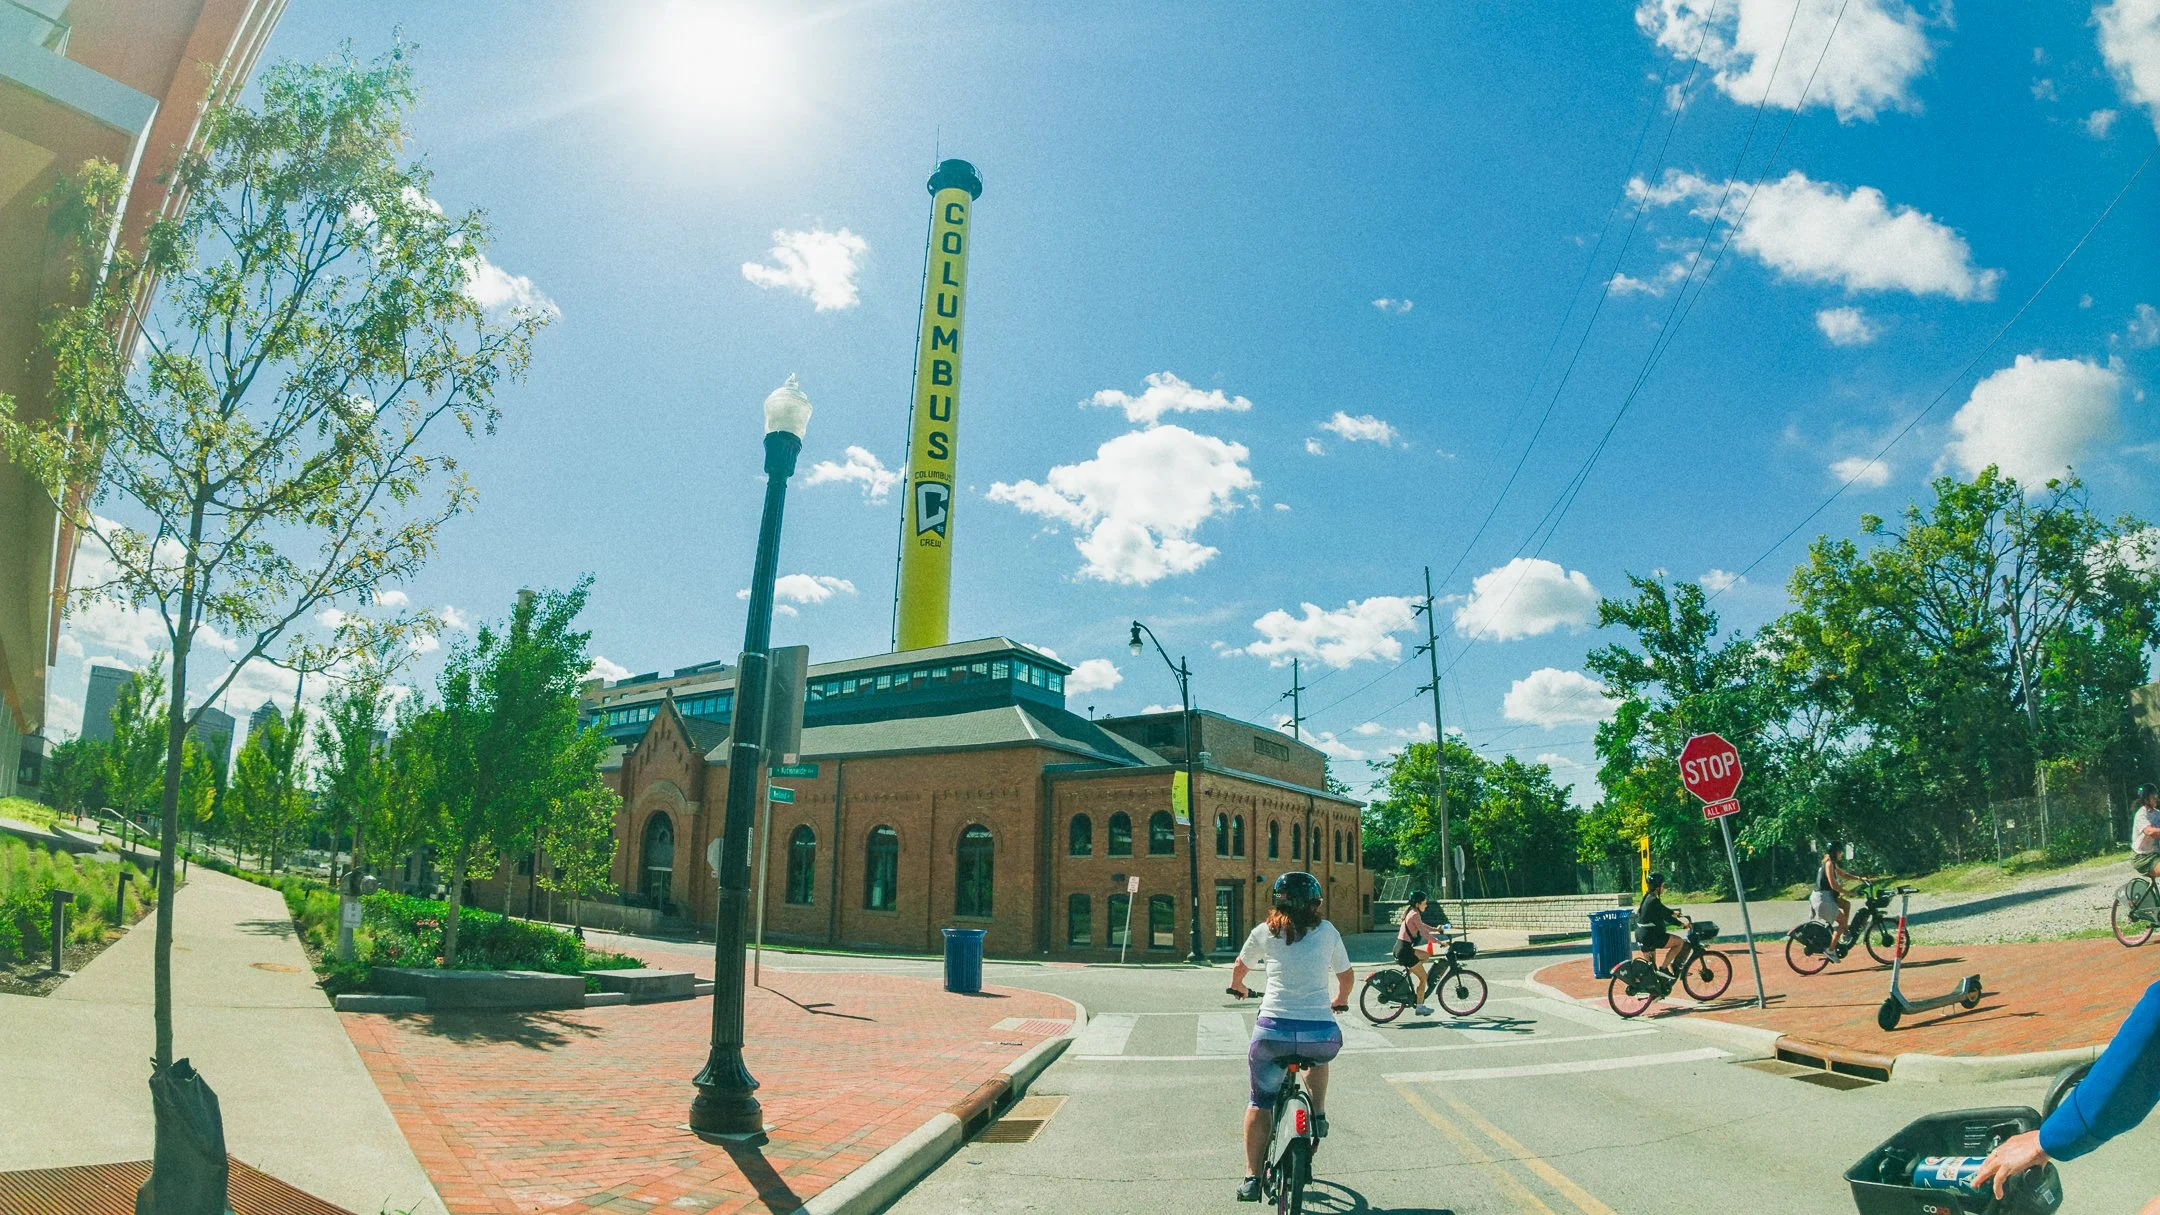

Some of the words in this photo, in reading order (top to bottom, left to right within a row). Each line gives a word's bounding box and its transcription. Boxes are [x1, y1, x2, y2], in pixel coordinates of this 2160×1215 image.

[927, 202, 965, 461] COLUMBUS
[914, 470, 952, 482] COLUMBUS
[919, 538, 942, 548] CREW
[1685, 752, 1734, 784] STOP
[1707, 807, 1719, 816] ALL
[1723, 802, 1737, 812] WAY
